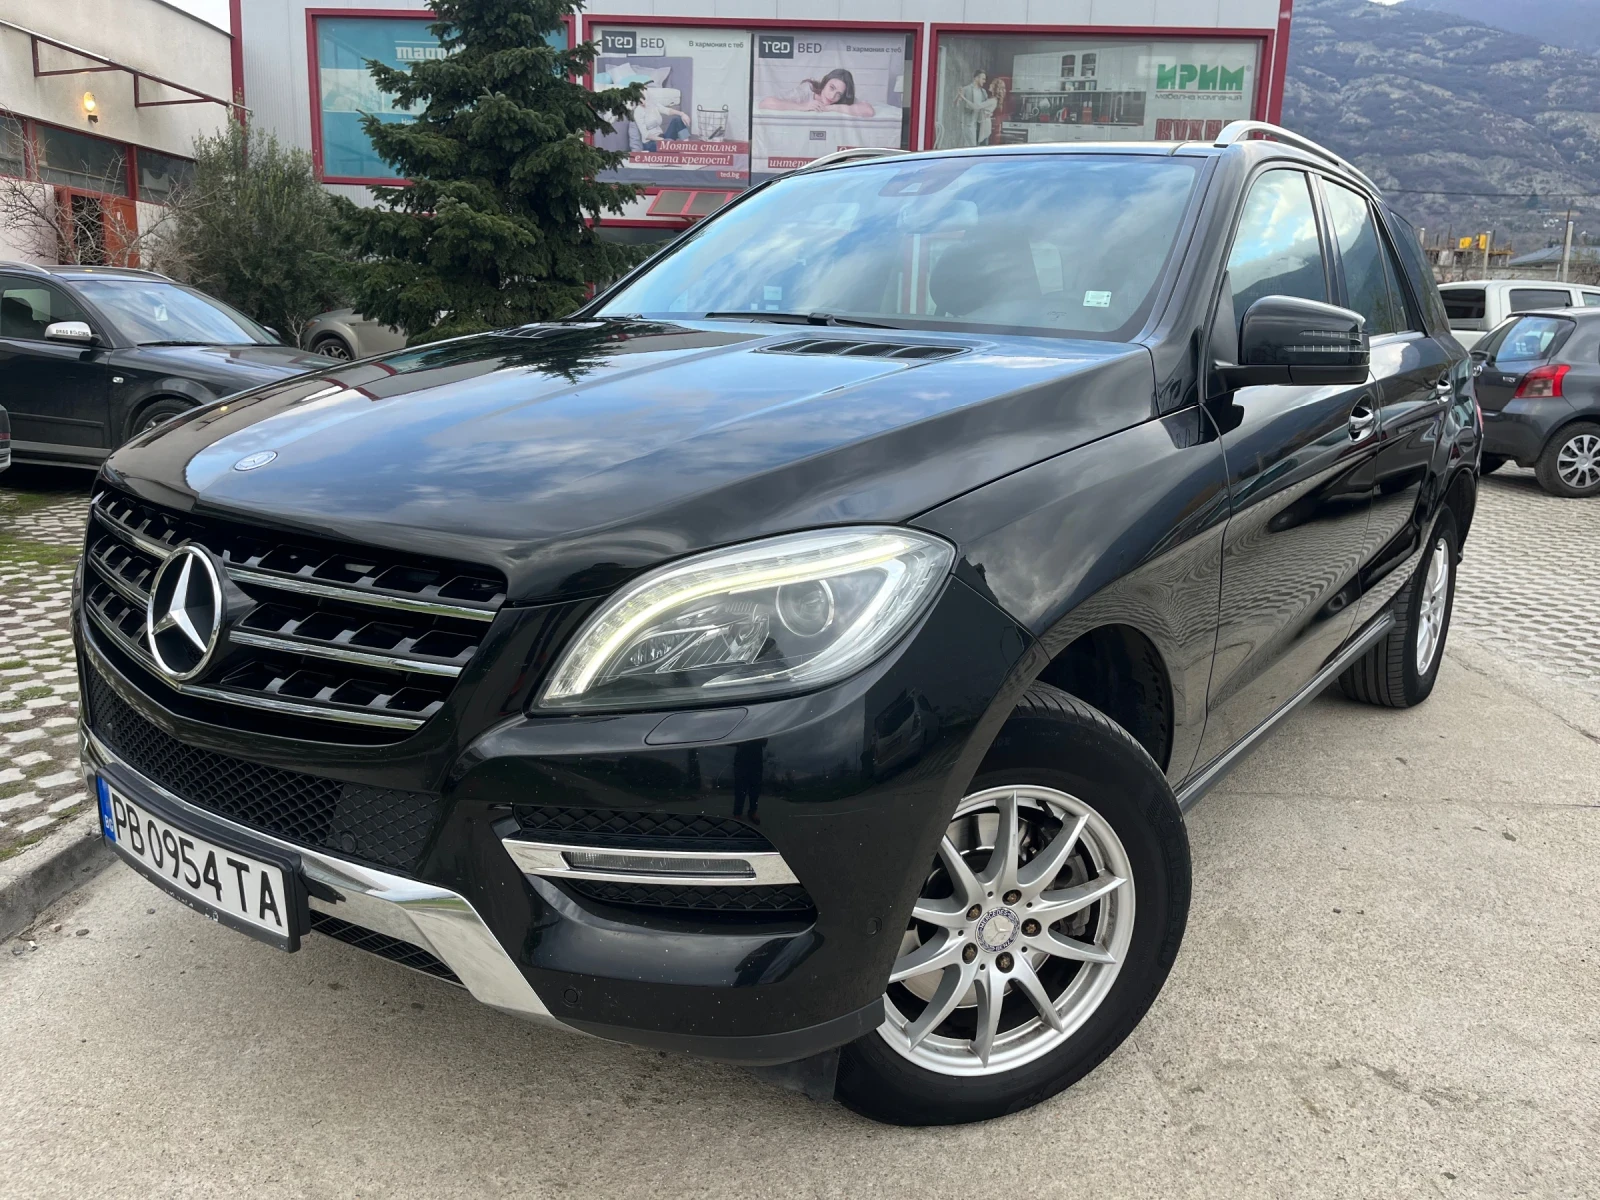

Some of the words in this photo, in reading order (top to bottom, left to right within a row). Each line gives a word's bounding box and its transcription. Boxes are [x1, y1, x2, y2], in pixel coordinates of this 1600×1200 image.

[640, 38, 665, 49] BED
[798, 43, 822, 53] BED
[1156, 64, 1245, 91] ИРИМ
[1155, 119, 1236, 141] КУХН
[659, 141, 698, 152] Моята
[700, 144, 738, 152] спалня
[642, 156, 679, 164] моята
[681, 155, 731, 165] крепост!
[720, 171, 740, 179] ted.bg
[104, 815, 115, 833] BG
[111, 792, 145, 856] PB
[147, 819, 222, 902] 0954
[226, 857, 283, 928] TA
